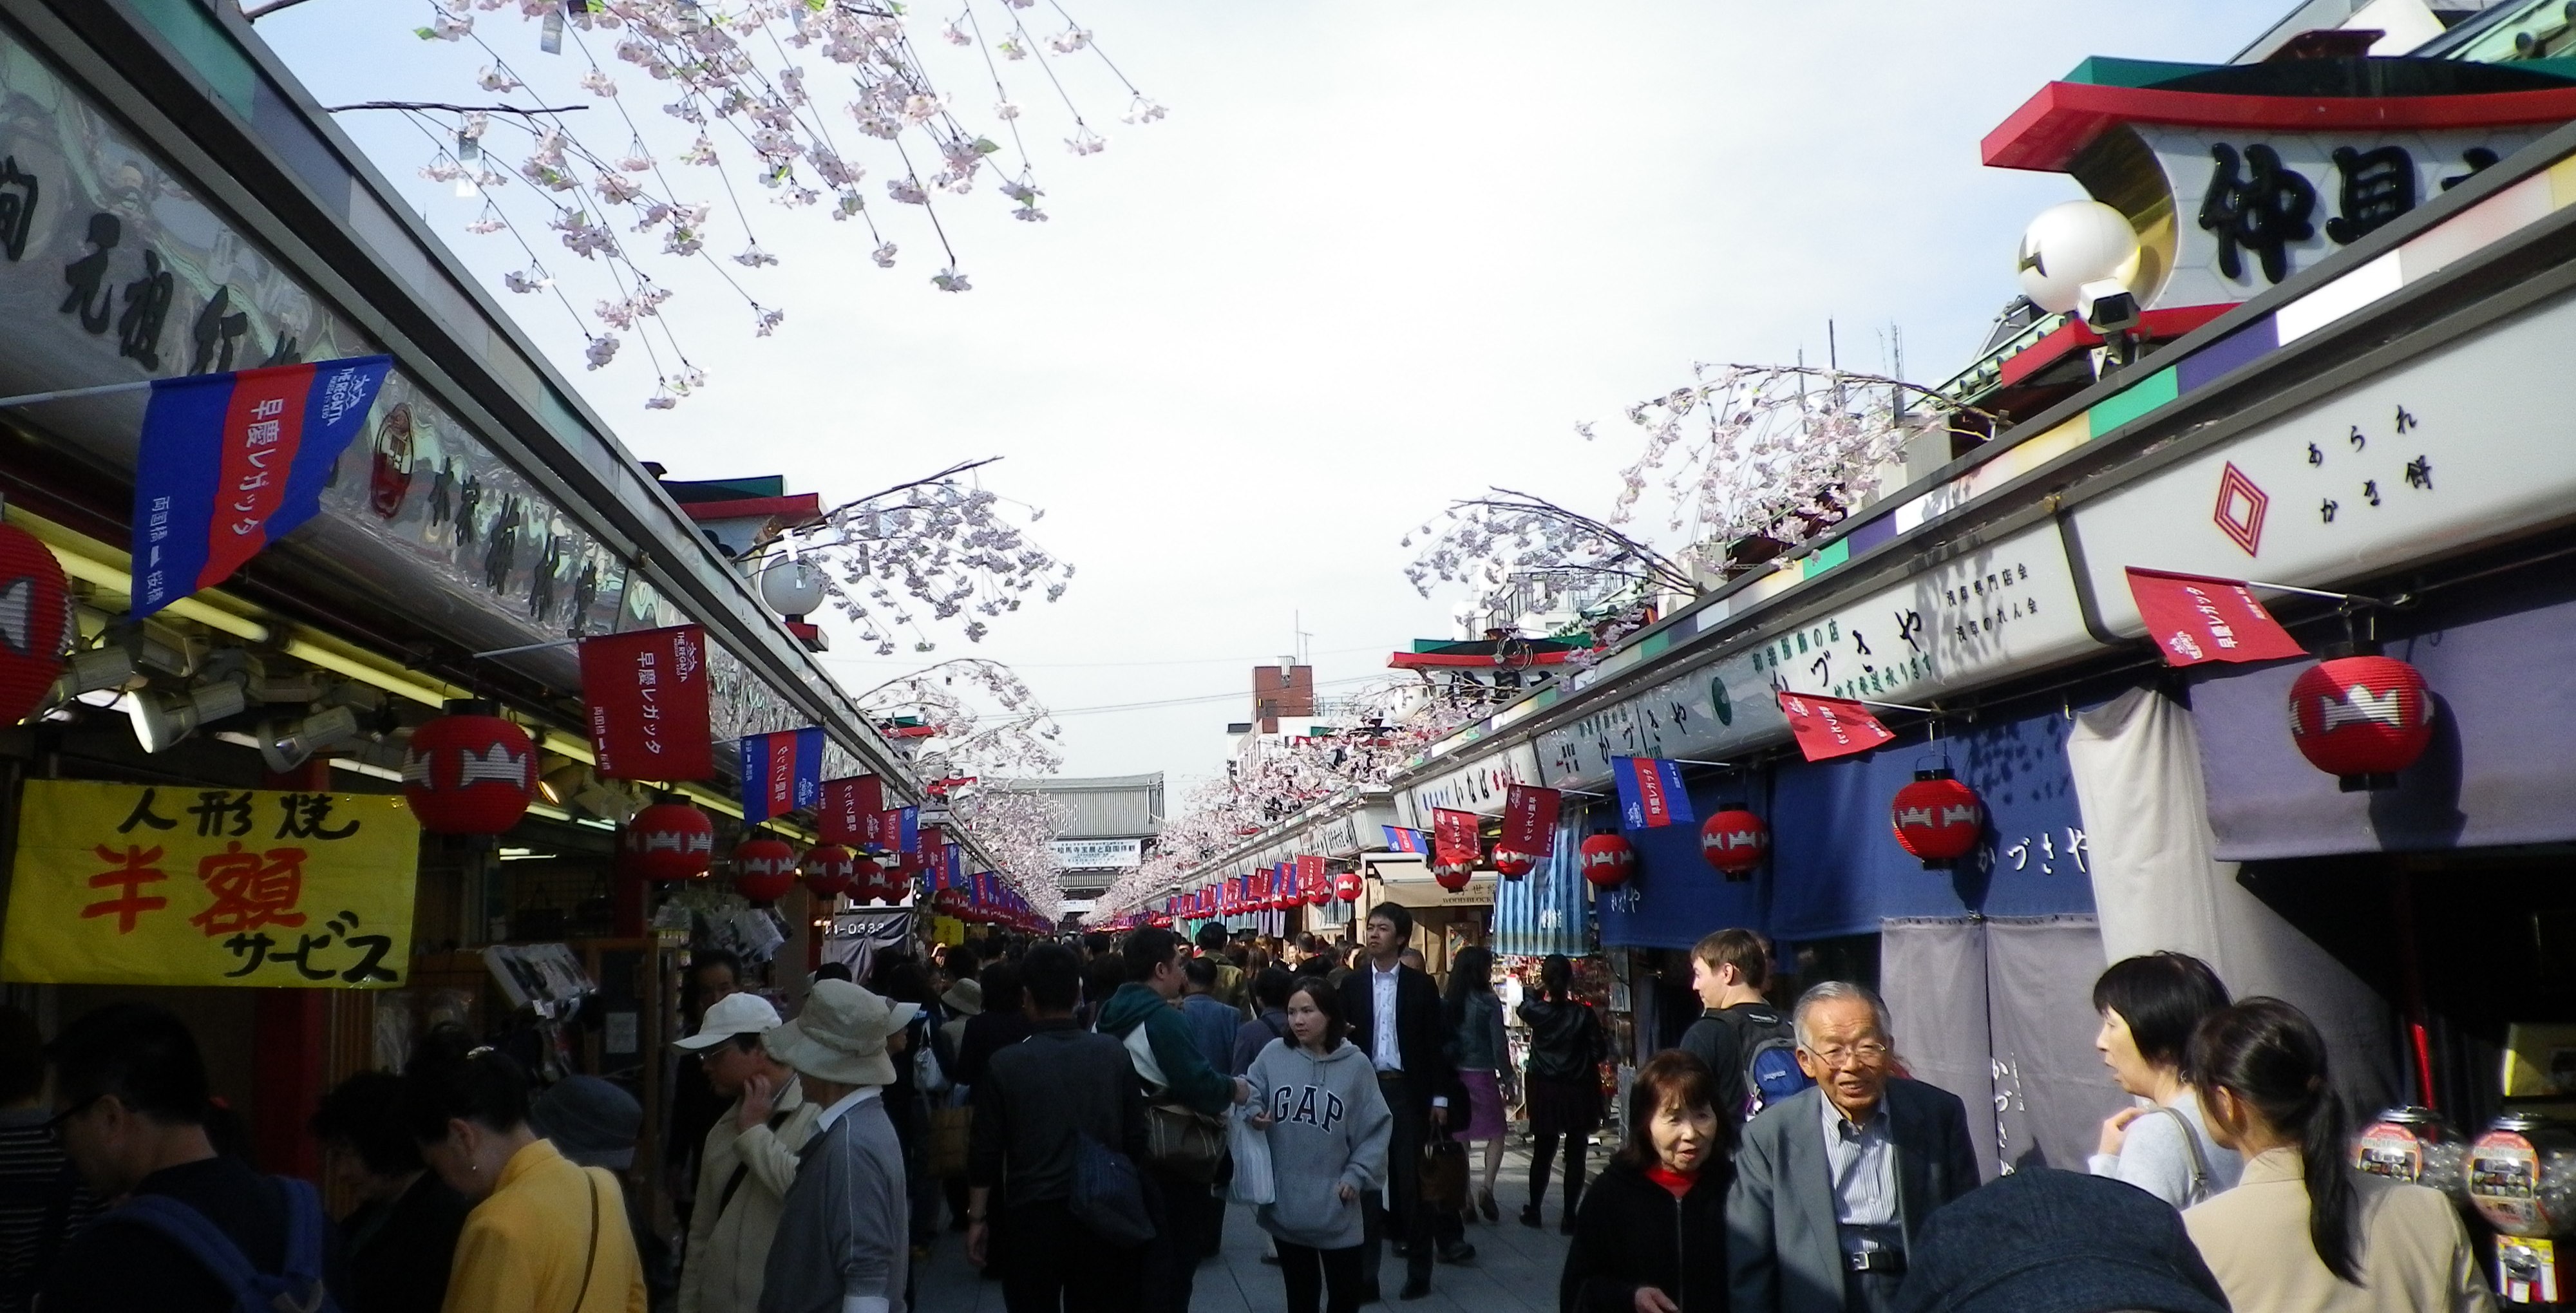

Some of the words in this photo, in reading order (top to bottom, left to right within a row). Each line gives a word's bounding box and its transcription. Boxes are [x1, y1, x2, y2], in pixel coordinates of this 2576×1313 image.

[2199, 143, 2500, 284] 仲見
[2308, 404, 2418, 466] あられ
[232, 399, 283, 535] 早慶レガッタ
[150, 496, 170, 542] 両国橋
[146, 571, 163, 605] 桜橋
[1946, 563, 2028, 607] 浅草専門店会
[1956, 598, 2038, 643] 浅草のれん会
[2186, 586, 2238, 648] 早慶レガッタ
[678, 647, 688, 683] REGATTA
[637, 652, 661, 754] 早慶レガッタ
[118, 788, 359, 840] 人形焼
[1643, 769, 1661, 815] 早慶レガッタ
[81, 841, 308, 937] 半額
[223, 911, 398, 983] サービス
[1274, 1085, 1345, 1134] GAP
